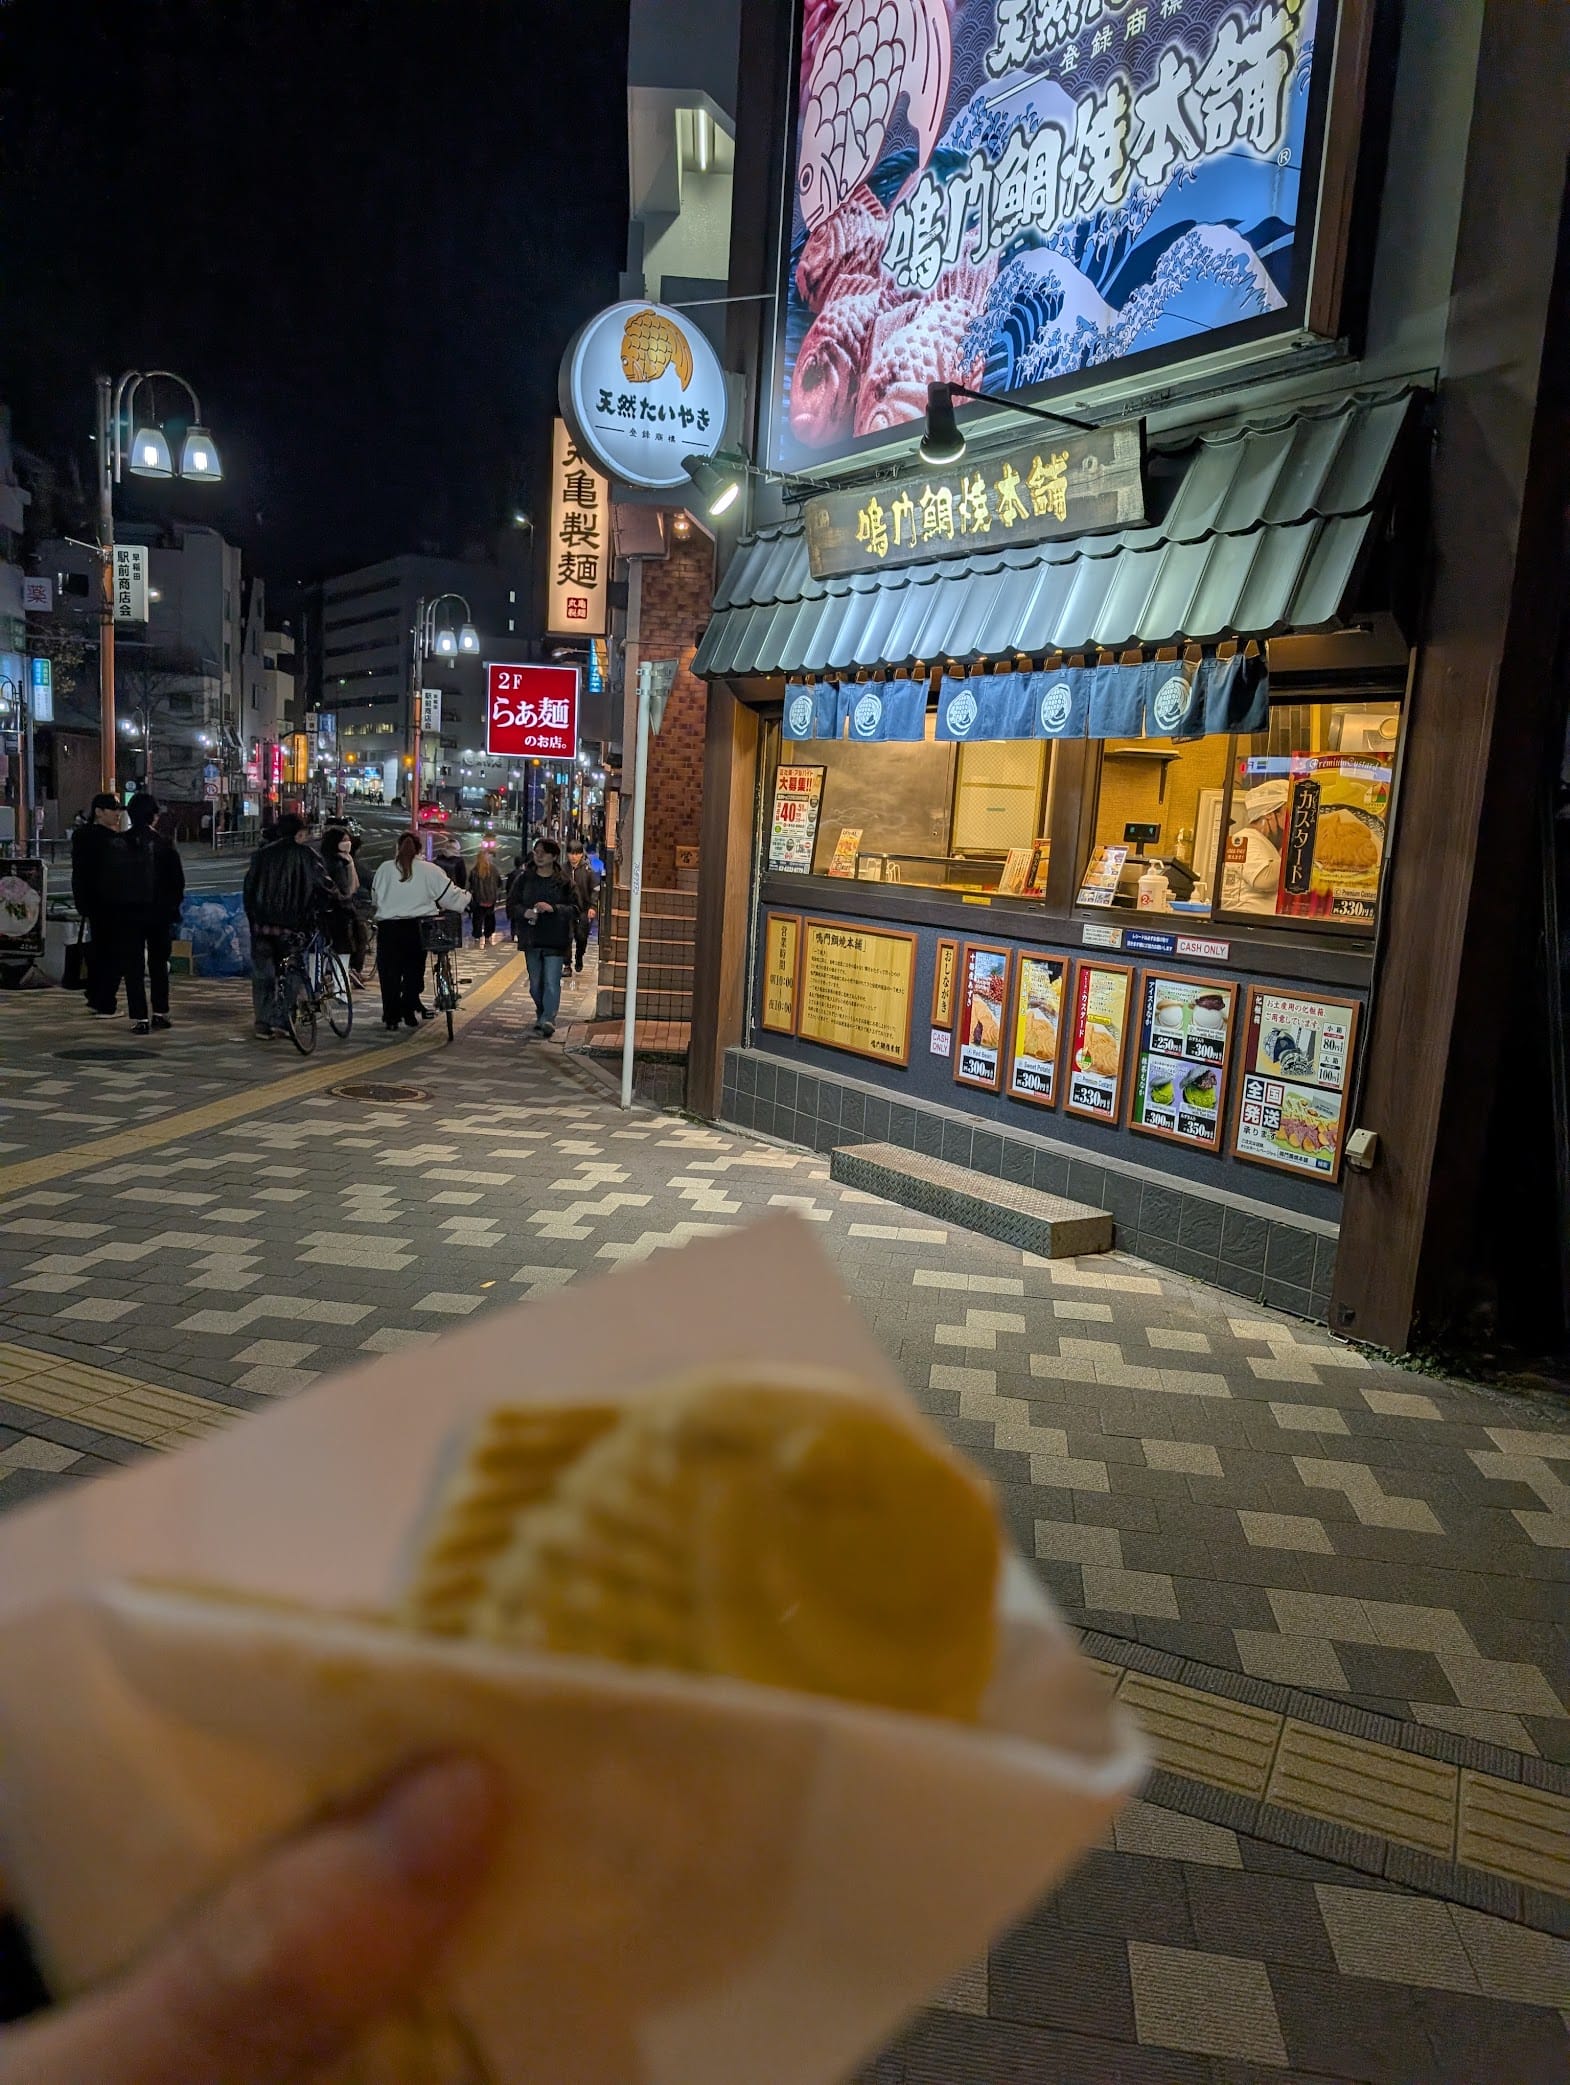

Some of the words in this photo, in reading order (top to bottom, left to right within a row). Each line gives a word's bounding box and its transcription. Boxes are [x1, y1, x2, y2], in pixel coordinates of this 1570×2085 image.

[596, 388, 711, 432] 天然たいやき
[132, 553, 141, 580] 早稲田
[27, 585, 48, 603] 薬
[117, 551, 132, 616] 駅前商店会
[498, 672, 522, 690] 2F
[493, 696, 570, 729] らあ麺
[524, 735, 567, 750] のお店。
[781, 802, 797, 823] 40
[1293, 790, 1313, 884] カスタード
[1180, 942, 1201, 953] CASH
[1204, 945, 1226, 956] ONLY
[941, 951, 952, 1013] おしながき
[932, 1032, 949, 1043] CASH
[932, 1042, 948, 1055] ONLY
[1244, 1103, 1281, 1130] 発送
